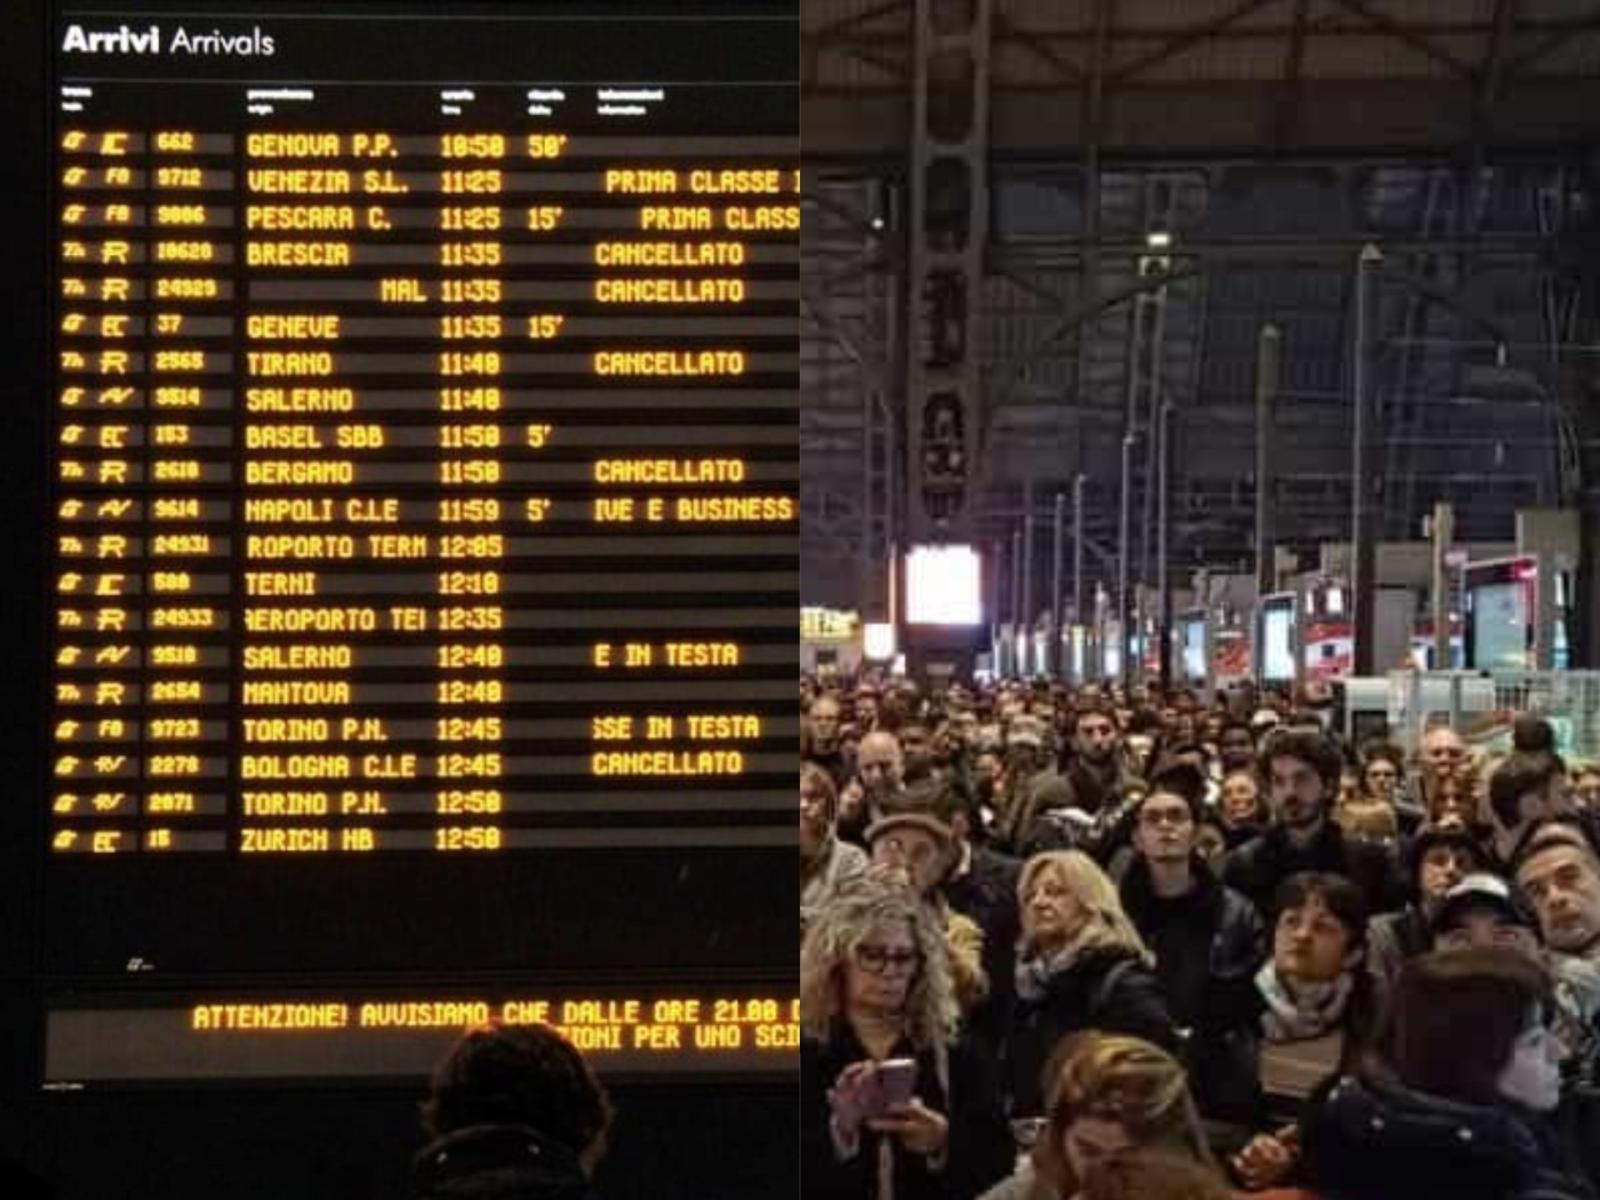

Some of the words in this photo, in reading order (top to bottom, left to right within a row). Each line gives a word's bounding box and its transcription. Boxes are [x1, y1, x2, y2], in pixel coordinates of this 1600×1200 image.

[63, 25, 159, 53] Arrivi
[170, 27, 274, 55] Arrivals
[248, 134, 339, 157] GENOVA
[442, 135, 505, 157] 10:50
[248, 170, 350, 193] VENEZIA
[442, 170, 501, 193] 11:25
[606, 170, 676, 192] PRIMA
[690, 171, 779, 193] CLASSE
[247, 206, 354, 229] PESCARA
[368, 207, 391, 229] C.
[442, 207, 500, 229] 11:25
[641, 207, 711, 229] PRIMA
[726, 207, 800, 229] CLASS
[247, 243, 349, 265] BRESCIA
[442, 243, 500, 265] 11:35
[596, 243, 743, 265] CANCELLATO
[381, 280, 427, 302] MAL
[442, 280, 500, 302] 11:35
[596, 280, 744, 302] CANCELLATO
[158, 315, 181, 332] 37
[248, 316, 339, 338] GENEVE
[442, 316, 501, 338] 11:35
[248, 353, 332, 375] TIRANO
[441, 352, 500, 374] 11:40
[595, 352, 743, 374] CANCELLATO
[247, 389, 353, 411] SALERNO
[441, 388, 500, 410] 11:40
[247, 426, 322, 448] BASEL
[338, 426, 383, 447] SBB
[441, 425, 500, 447] 11:50
[246, 462, 352, 484] BERGAMO
[441, 461, 499, 483] 11:50
[595, 460, 743, 482] CANCELLATO
[246, 499, 332, 521] NAPOLI
[440, 499, 499, 521] 11:59
[648, 499, 663, 520] E
[678, 498, 792, 520] BUSINESS
[248, 536, 353, 558] ROPORTO
[369, 536, 426, 557] TERM
[440, 535, 502, 557] 12:05
[246, 573, 315, 595] TERNI
[440, 572, 498, 593] 12:10
[440, 607, 502, 629] 12:35
[244, 646, 351, 669] SALERNO
[439, 645, 502, 667] 12:40
[595, 644, 610, 666] E
[626, 644, 651, 666] IN
[666, 644, 738, 665] TESTA
[243, 682, 349, 704] MANTOVA
[438, 681, 502, 703] 12:40
[244, 719, 328, 741] TORINO
[438, 718, 501, 740] 12:45
[647, 717, 672, 738] IN
[688, 716, 759, 738] TESTA
[242, 756, 349, 778] BOLOGNA
[438, 754, 501, 776] 12:45
[593, 752, 742, 775] CANCELLATO
[243, 793, 327, 815] TORINO
[438, 791, 501, 813] 12:50
[241, 829, 328, 851] ZURICH
[342, 828, 373, 850] HB
[437, 827, 500, 849] 12:50
[193, 1004, 347, 1029] ATTENZIONE!
[361, 1002, 489, 1027] AVVISIAMO
[502, 1002, 549, 1023] CHE
[563, 1001, 639, 1023] DALLE
[654, 1000, 699, 1023] ORE
[714, 1000, 778, 1023] 21.00
[635, 1025, 680, 1048] PER
[695, 1025, 741, 1048] UNO
